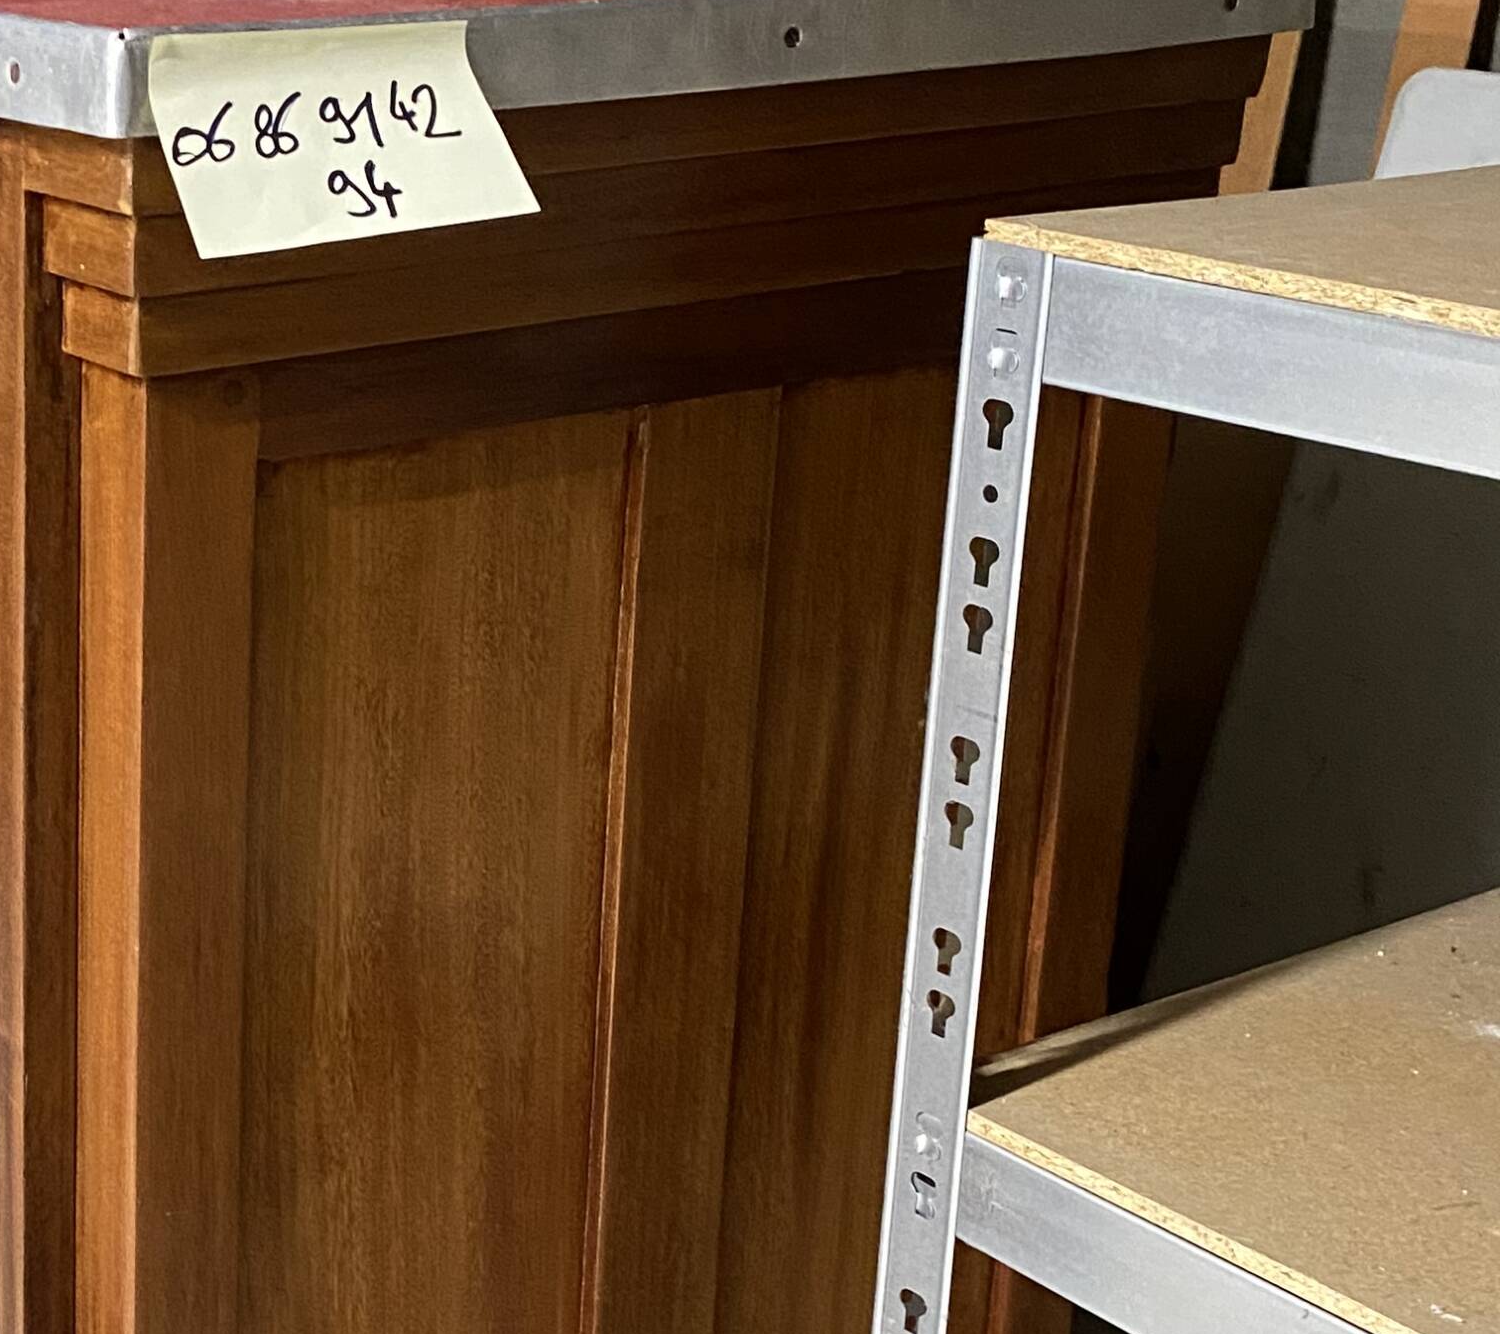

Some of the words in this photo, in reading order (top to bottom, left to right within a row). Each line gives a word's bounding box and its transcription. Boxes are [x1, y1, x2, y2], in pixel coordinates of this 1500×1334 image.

[172, 102, 235, 166] 06
[255, 92, 301, 158] 86
[327, 160, 402, 218] 94
